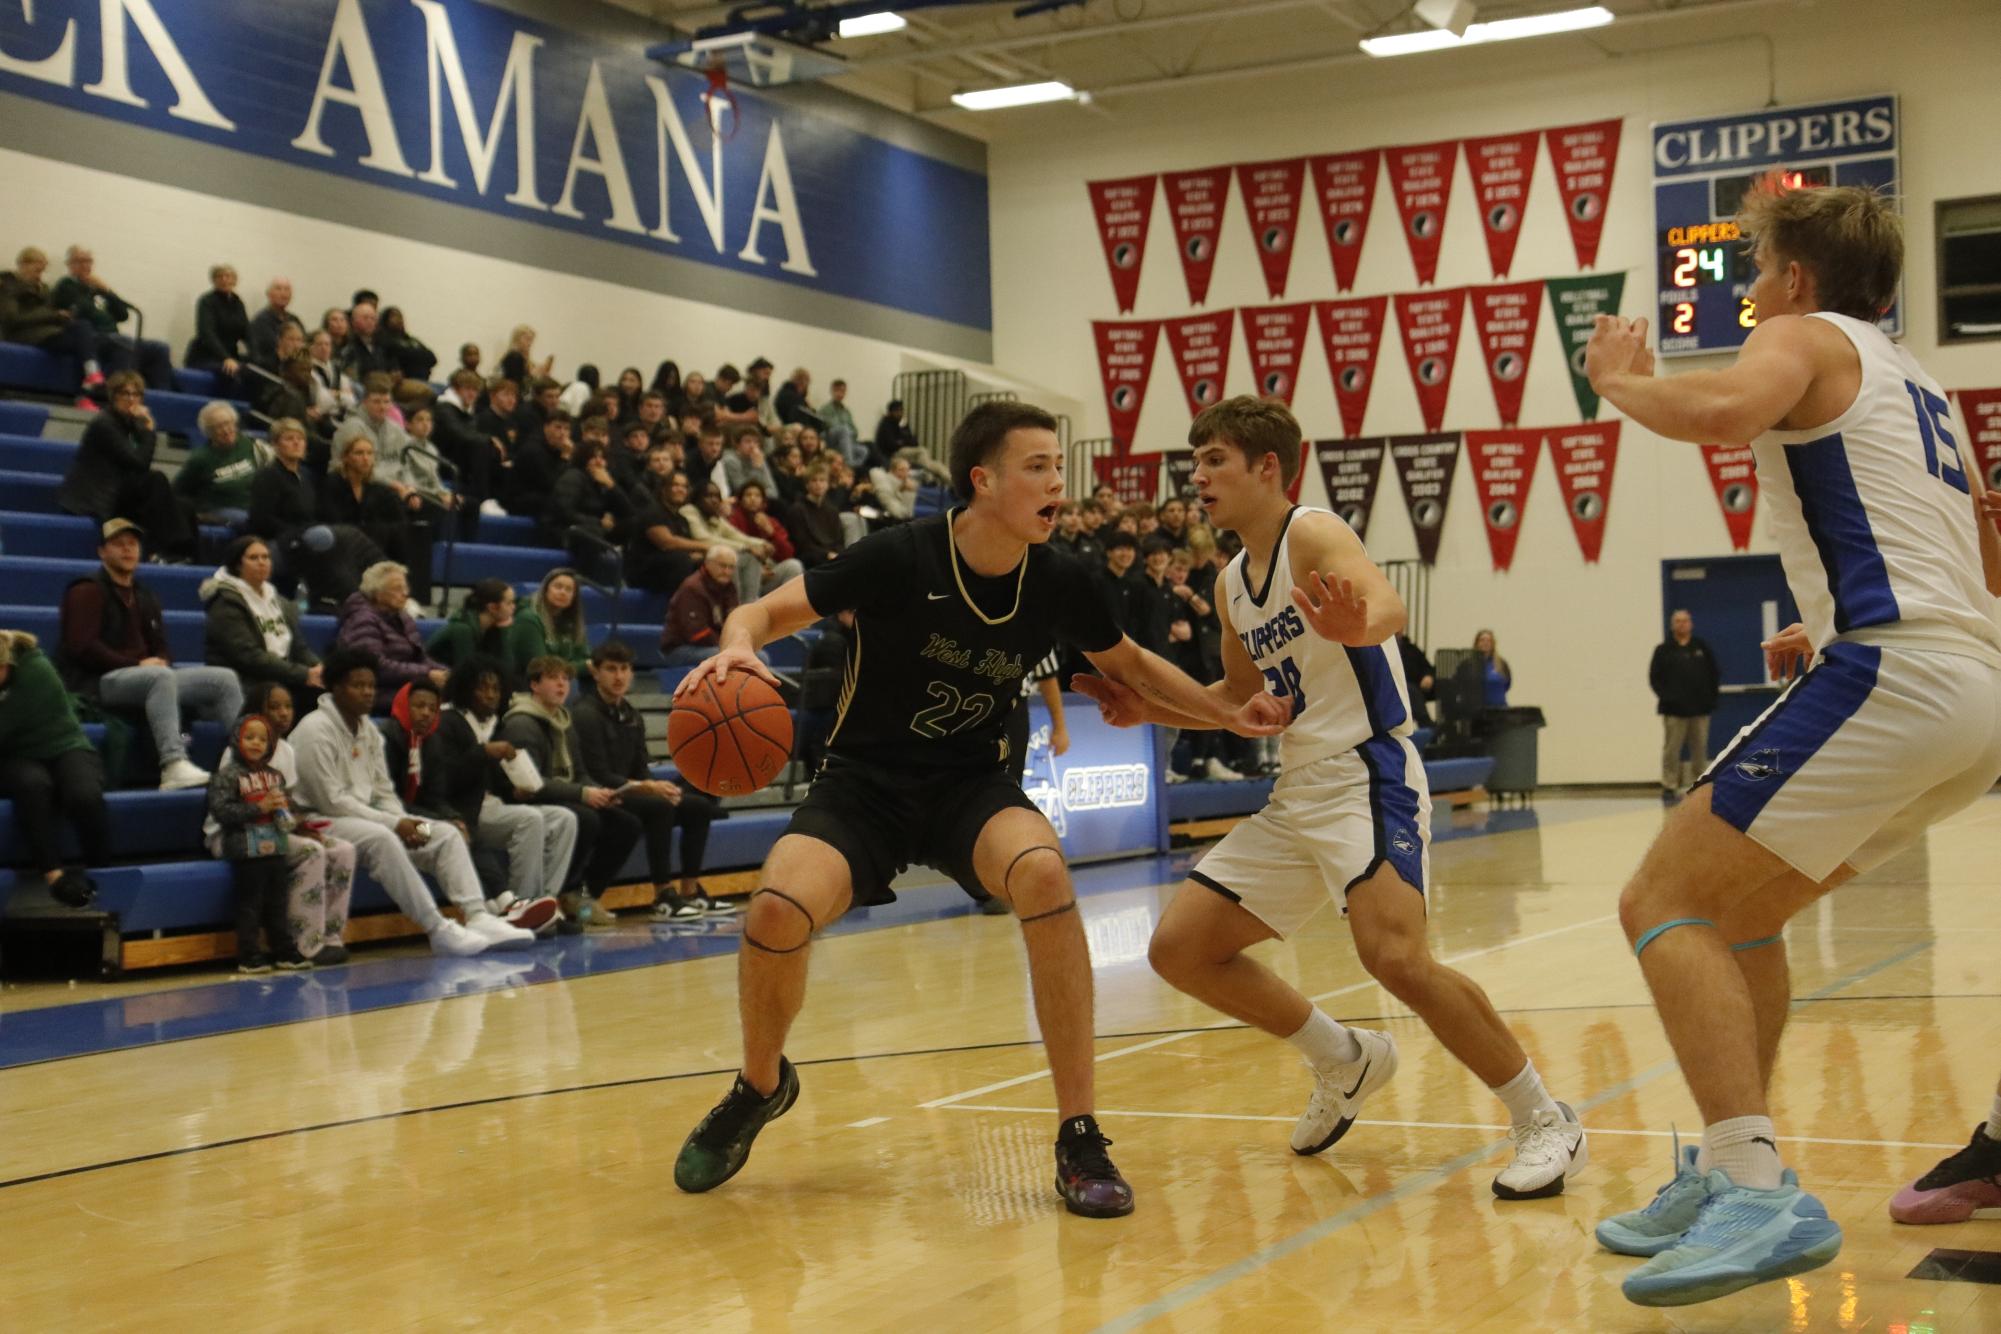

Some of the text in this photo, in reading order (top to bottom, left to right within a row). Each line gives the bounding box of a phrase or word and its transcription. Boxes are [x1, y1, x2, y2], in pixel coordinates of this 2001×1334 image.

[291, 0, 819, 278] AMANA
[1656, 106, 1893, 170] CLIPPERS
[1667, 222, 1741, 247] CLIPPERS
[1674, 247, 1724, 288] 24
[1660, 289, 1699, 305] FOULS
[1673, 301, 1695, 334] 2
[1661, 336, 1699, 351] SCORE
[1904, 378, 1971, 495] 15
[920, 632, 1023, 686] West High
[910, 680, 994, 739] 22
[1065, 767, 1147, 807] CLIPPERS
